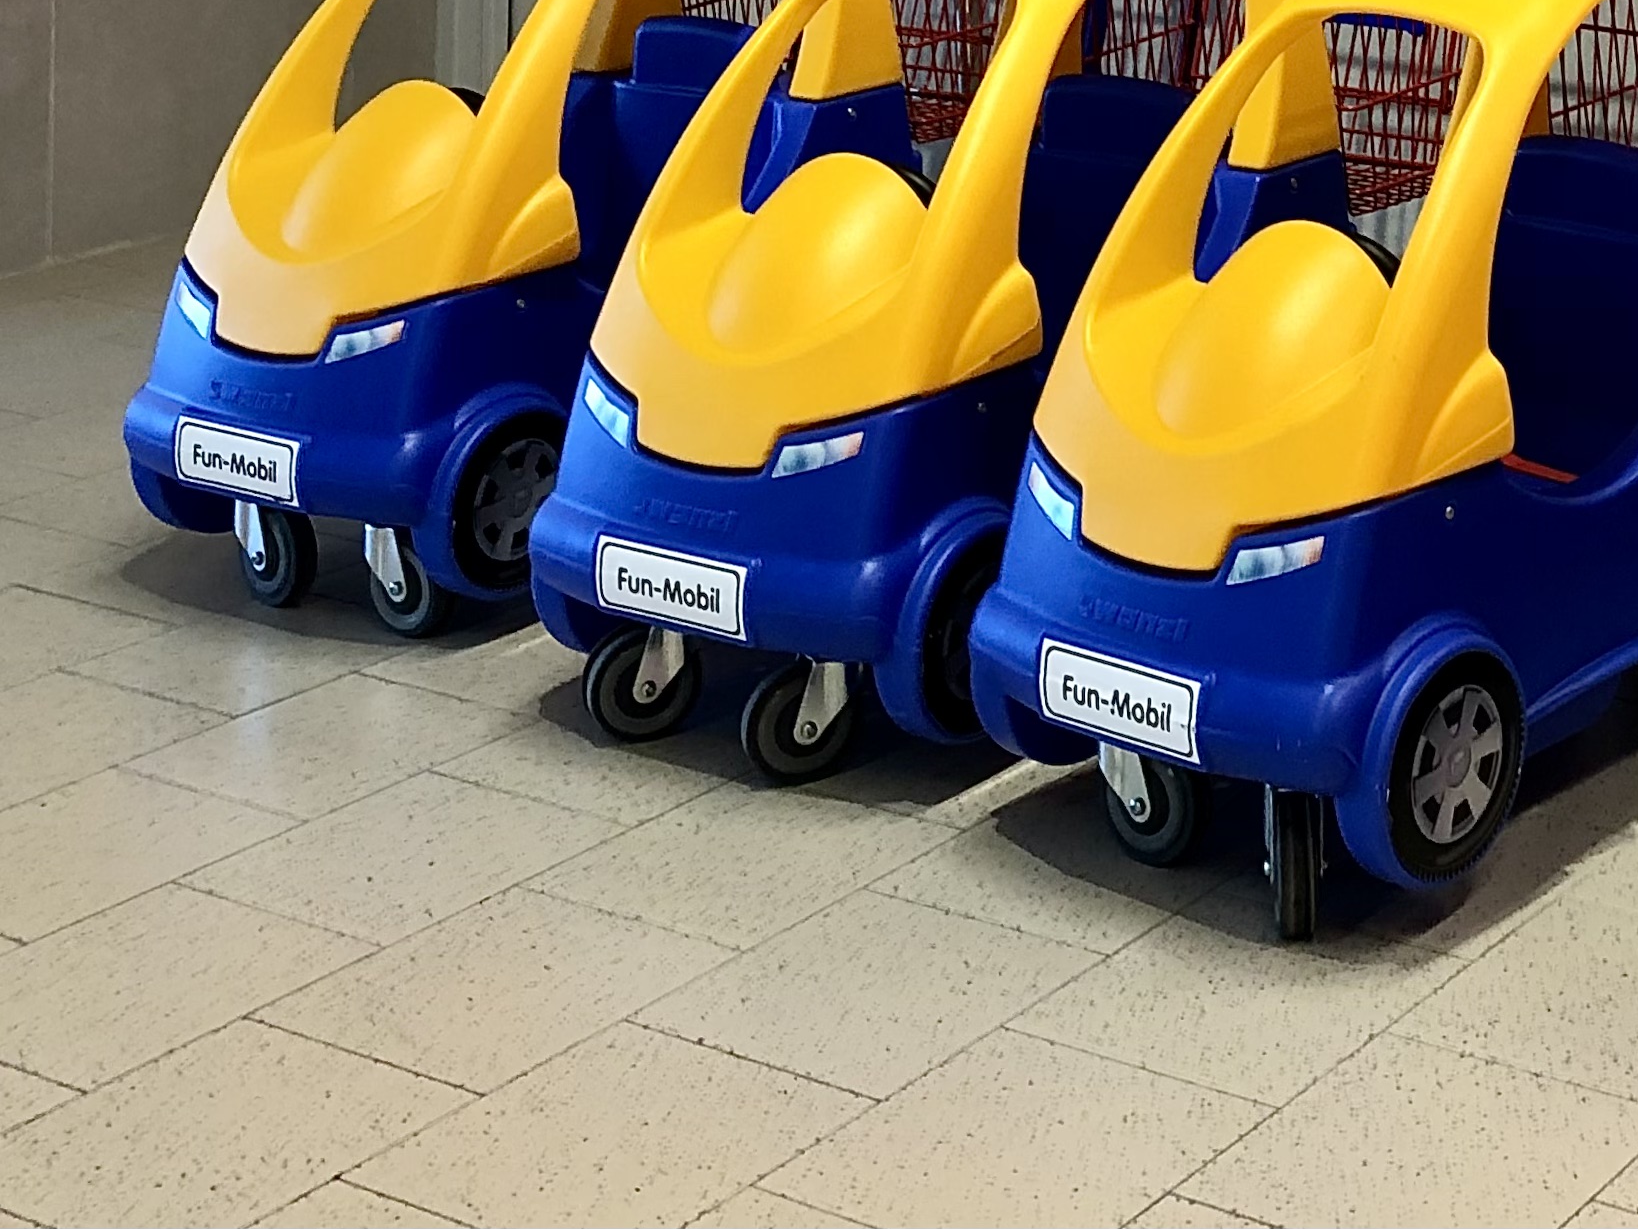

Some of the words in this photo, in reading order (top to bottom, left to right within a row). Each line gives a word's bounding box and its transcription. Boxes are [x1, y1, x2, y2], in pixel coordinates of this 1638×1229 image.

[192, 443, 277, 483] Fun-Mobil
[617, 566, 720, 614] Fun-Mobil
[1062, 674, 1172, 733] Fun-Mobil
